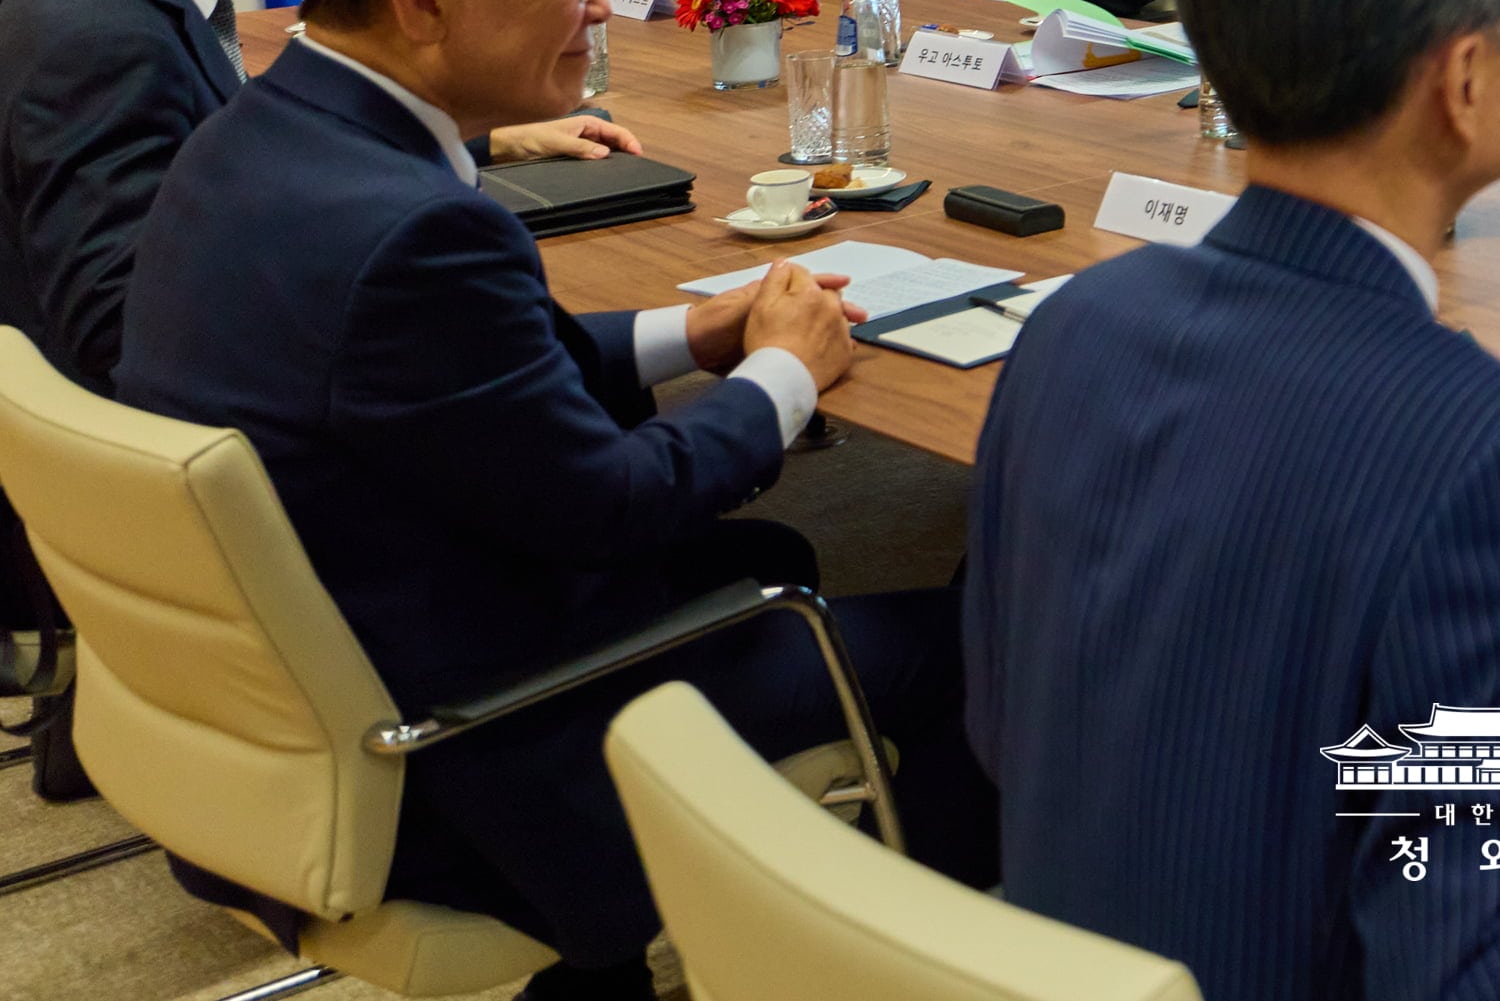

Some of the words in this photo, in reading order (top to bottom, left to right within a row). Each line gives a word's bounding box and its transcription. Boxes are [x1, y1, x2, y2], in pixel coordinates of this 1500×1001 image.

[918, 48, 939, 64] 우고
[942, 51, 984, 71] 아스투토
[1144, 199, 1189, 226] 이재명
